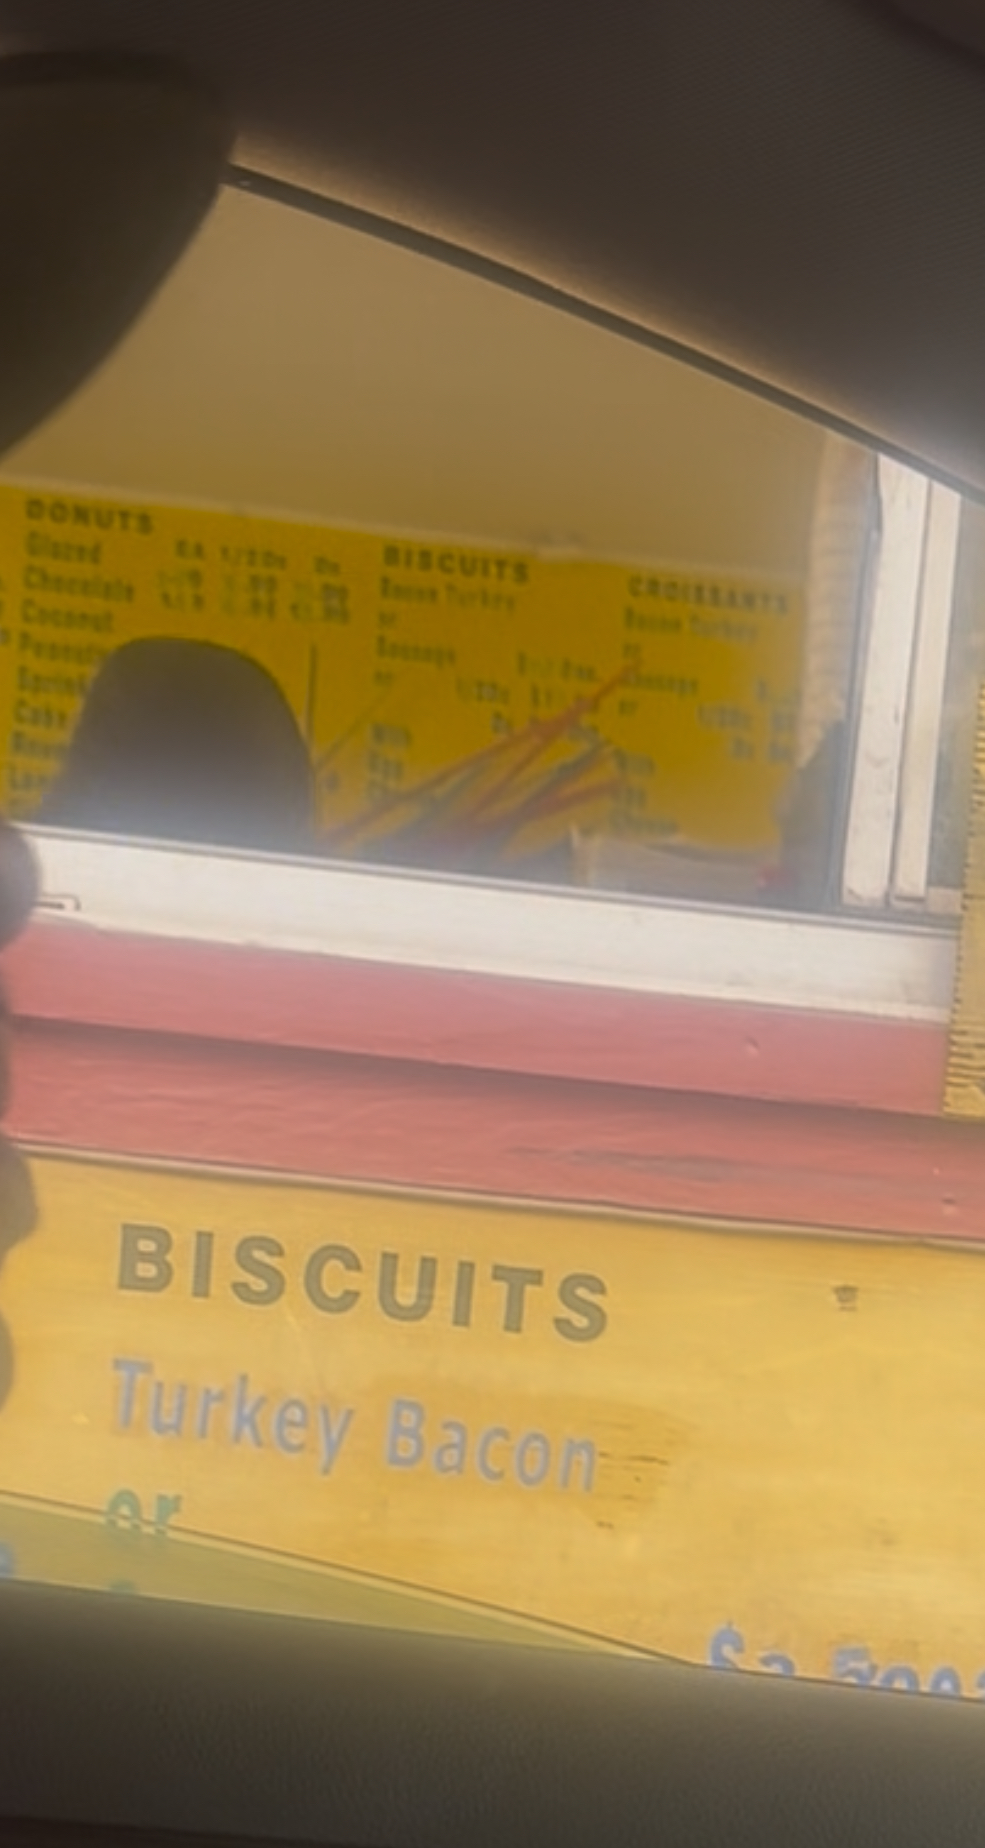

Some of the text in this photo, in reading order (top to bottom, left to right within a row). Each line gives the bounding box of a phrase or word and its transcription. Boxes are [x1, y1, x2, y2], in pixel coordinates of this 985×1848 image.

[25, 498, 154, 534] DONUTS
[26, 531, 102, 565] Glazed
[383, 544, 530, 584] BISCUITS
[23, 564, 136, 604] Chocolate
[379, 575, 439, 604] Bacon
[446, 583, 516, 615] Turkey
[627, 574, 789, 616] CROISSANTS
[21, 597, 115, 634] Coconut
[375, 634, 456, 670] Sausage
[117, 1222, 608, 1342] BISCUITS
[112, 1357, 597, 1494] Turkey Bacon
